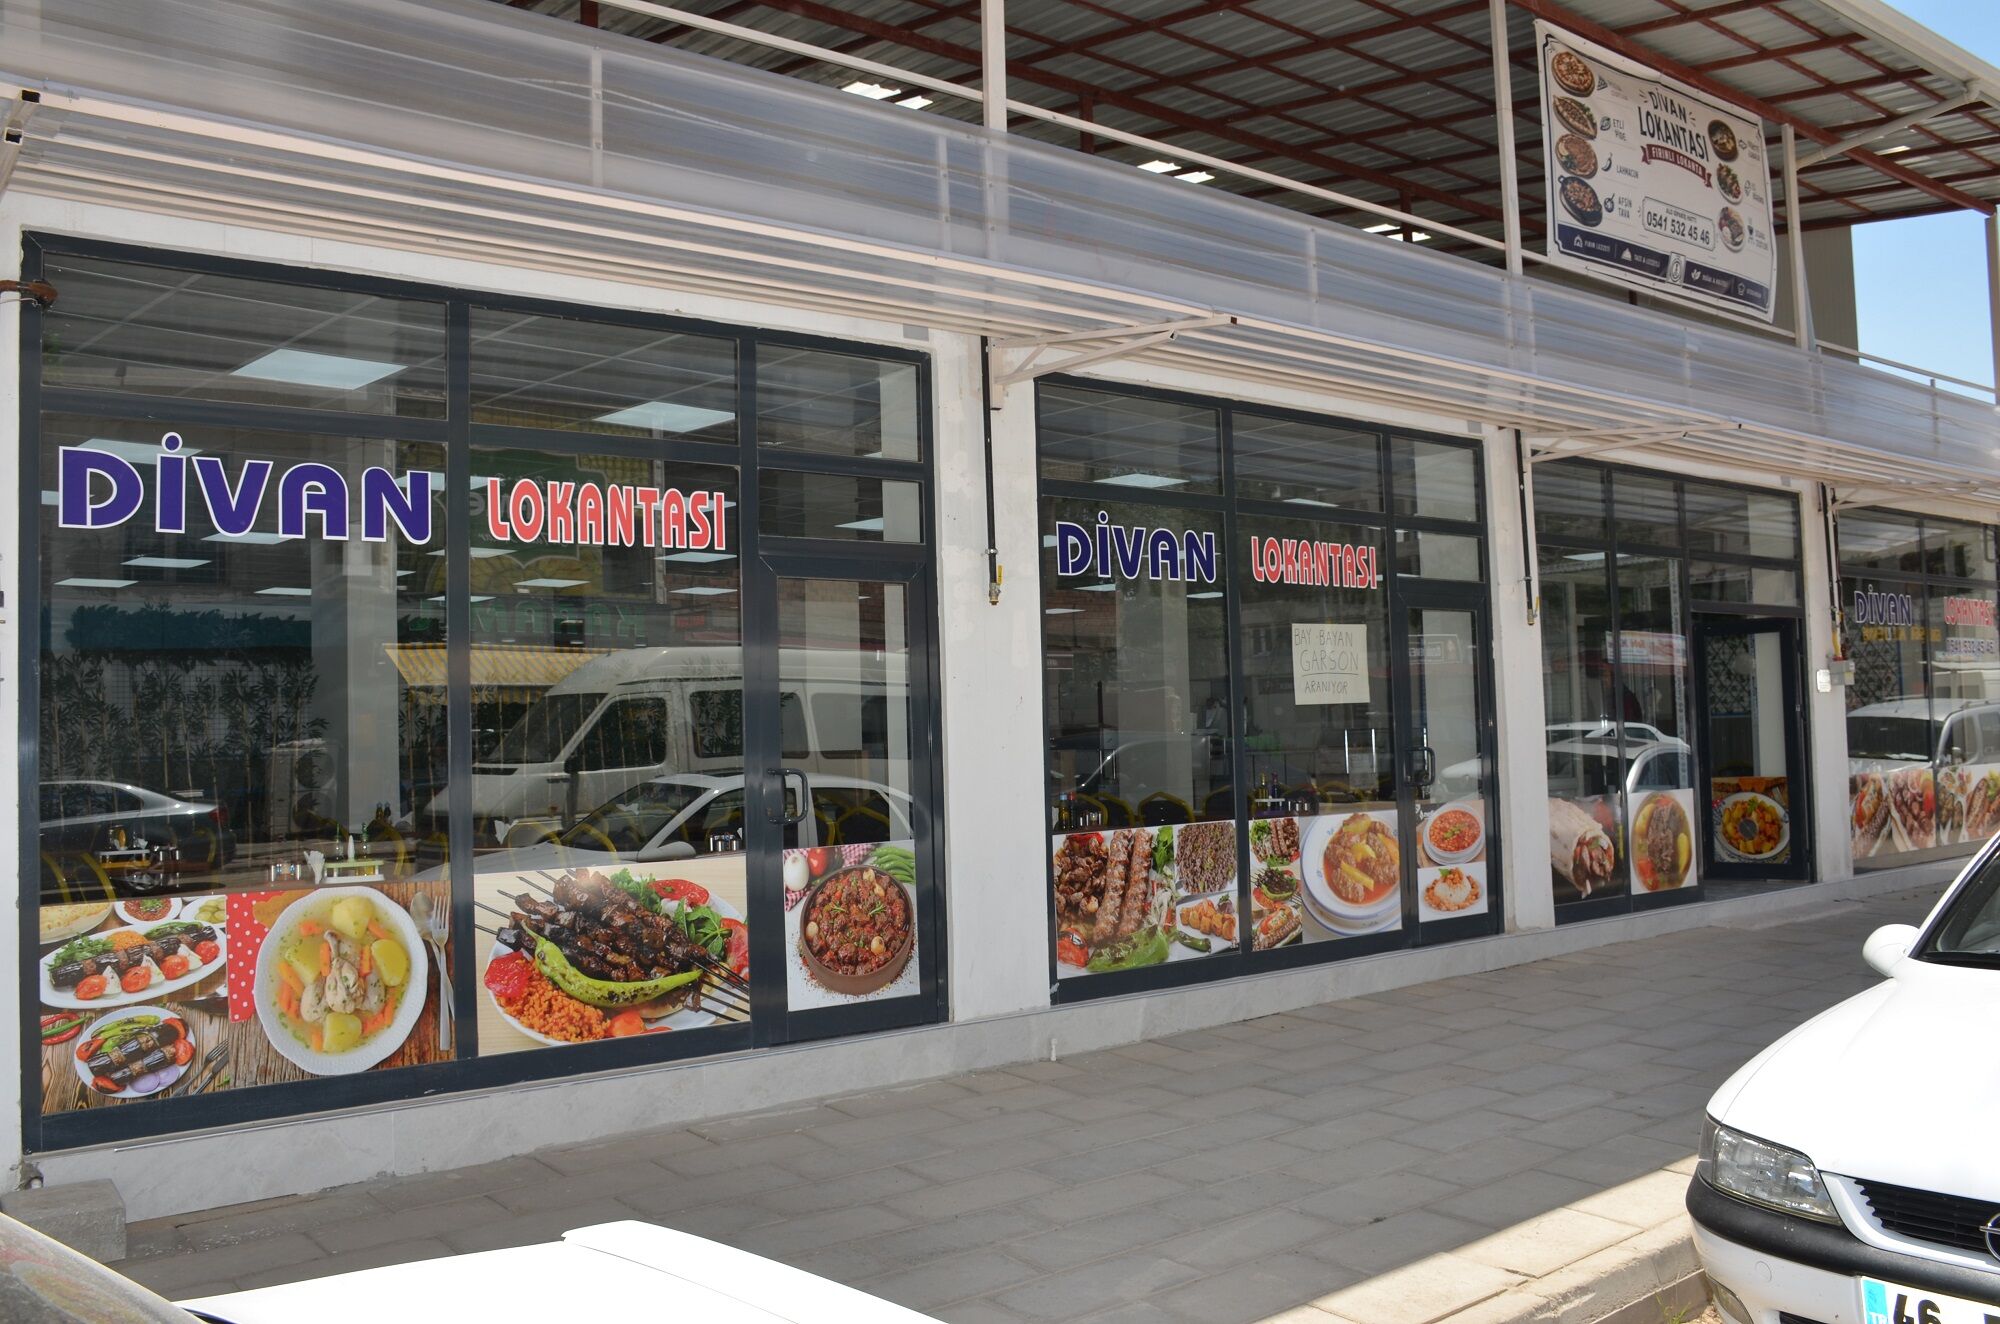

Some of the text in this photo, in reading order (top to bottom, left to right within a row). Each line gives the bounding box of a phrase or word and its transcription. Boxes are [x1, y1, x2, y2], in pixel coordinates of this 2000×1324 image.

[1648, 86, 1688, 124] DİVAN
[1637, 106, 1710, 162] LOKANTASI
[1646, 210, 1711, 246] 0541 532 45 46
[58, 431, 433, 545] DİVAN
[487, 477, 726, 551] LOKANTASI
[1056, 510, 1377, 590] DİVAN LOKANTASI
[1854, 583, 1913, 627] DİVAN
[1293, 627, 1312, 647] BAY
[1299, 648, 1360, 673] GARSON
[1304, 679, 1349, 696] ARANIYOR
